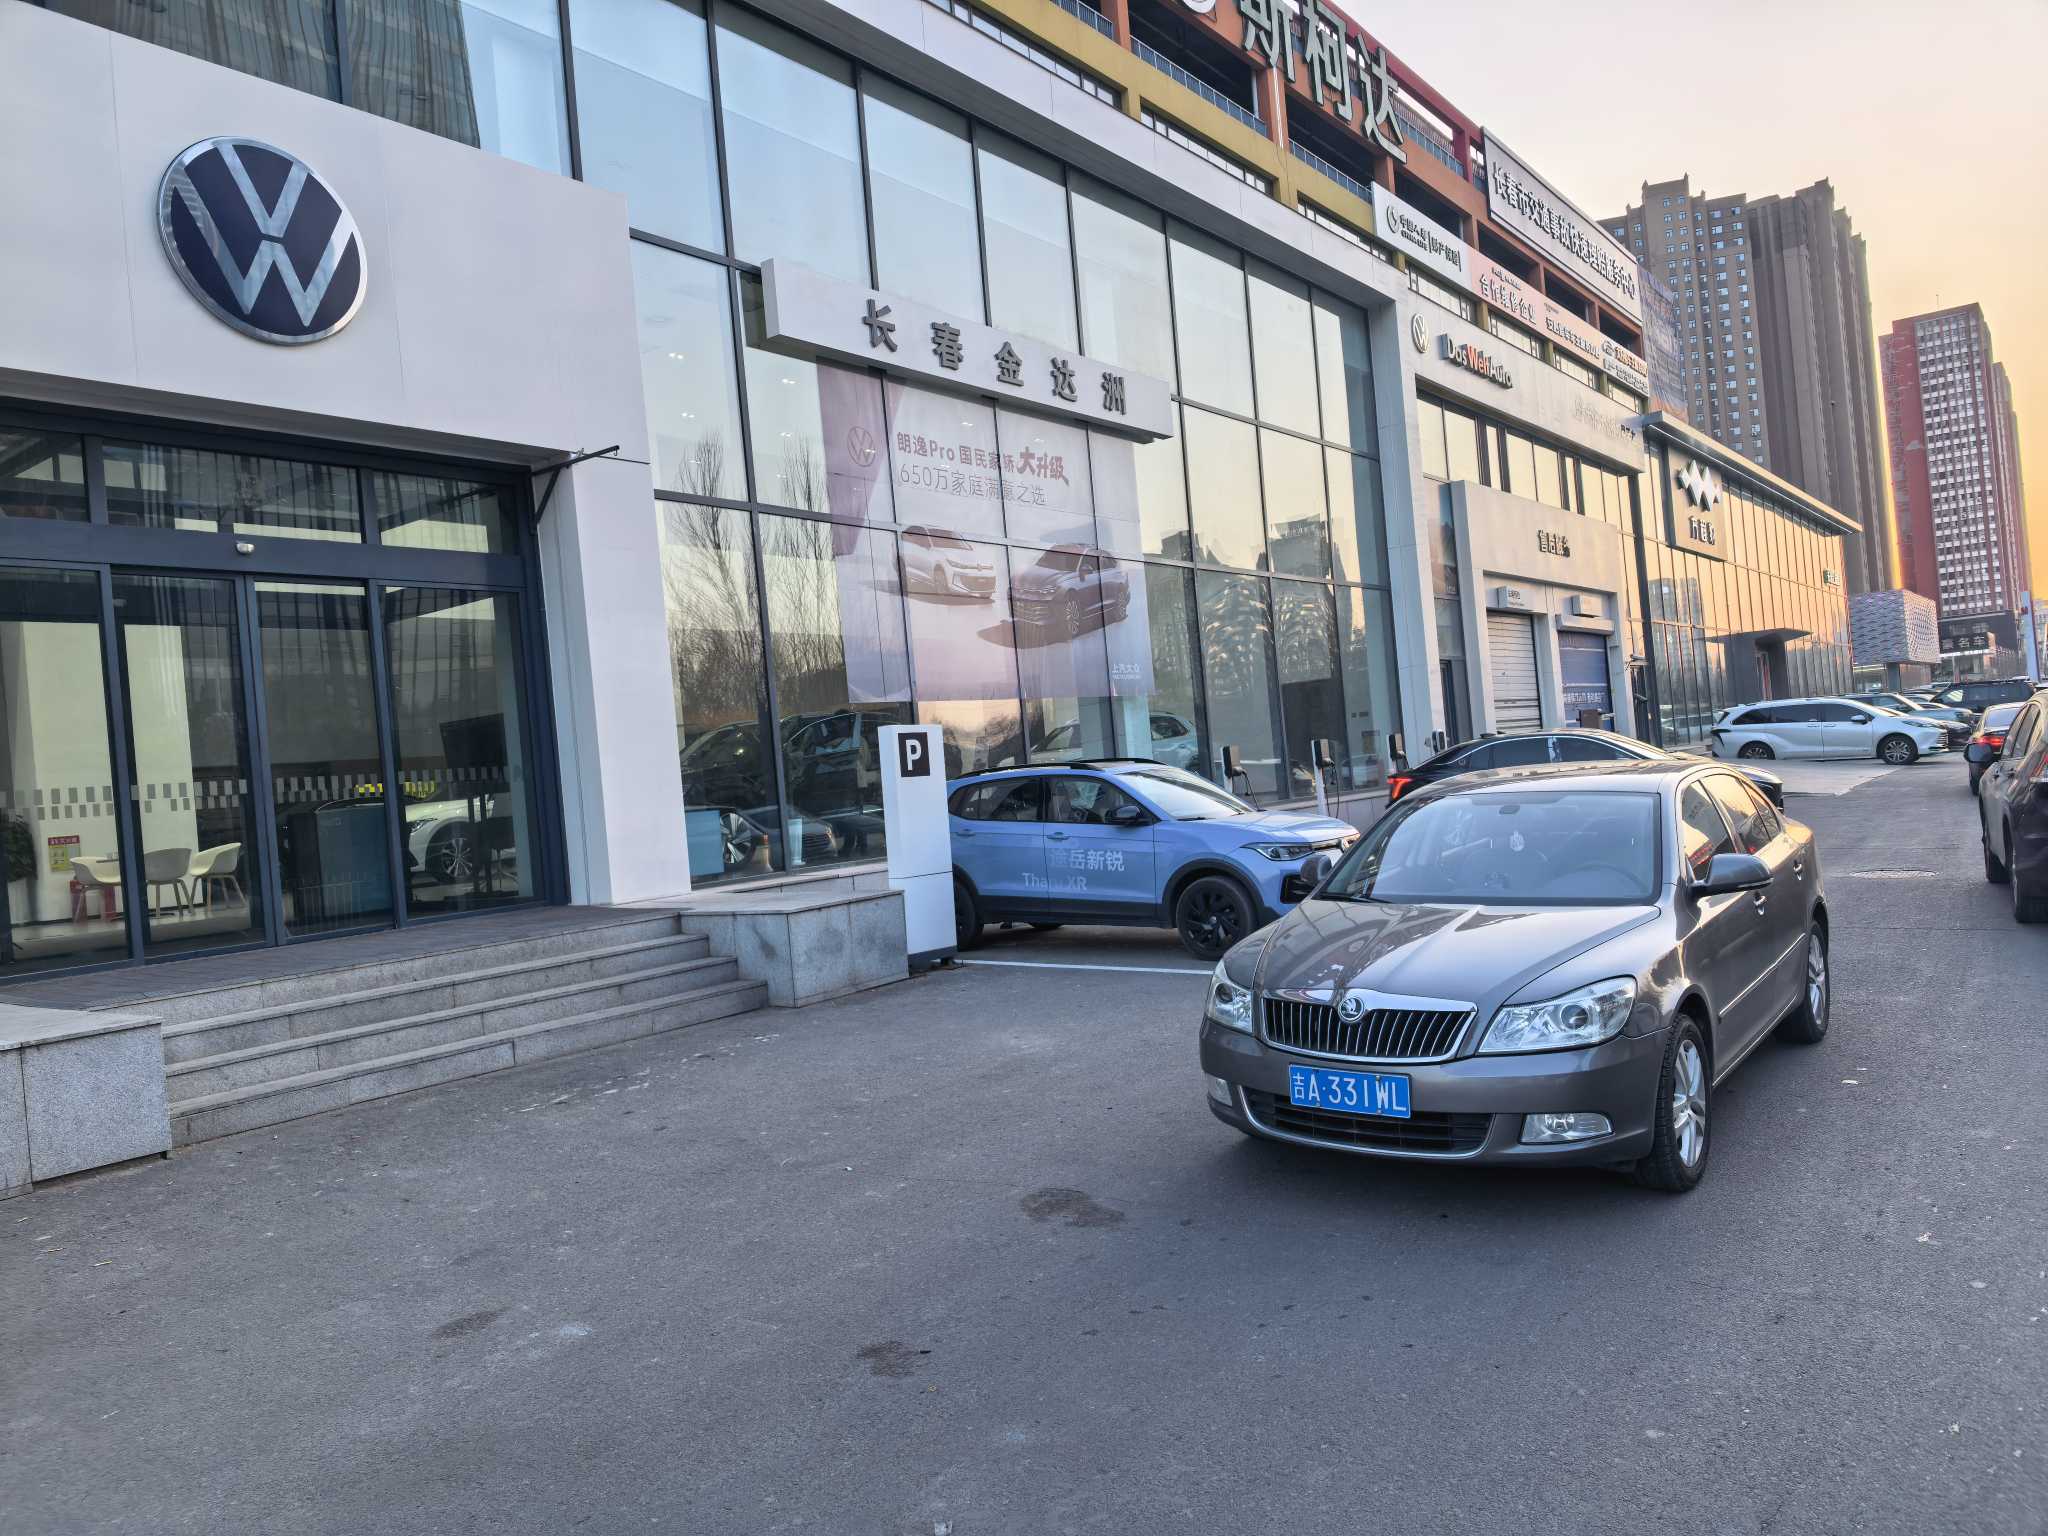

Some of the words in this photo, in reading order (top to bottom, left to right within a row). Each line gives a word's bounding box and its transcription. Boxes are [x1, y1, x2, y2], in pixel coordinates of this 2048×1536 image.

[862, 299, 1127, 415] 长春金达洲
[897, 432, 955, 461] 朗逸Pro
[906, 739, 921, 770] P
